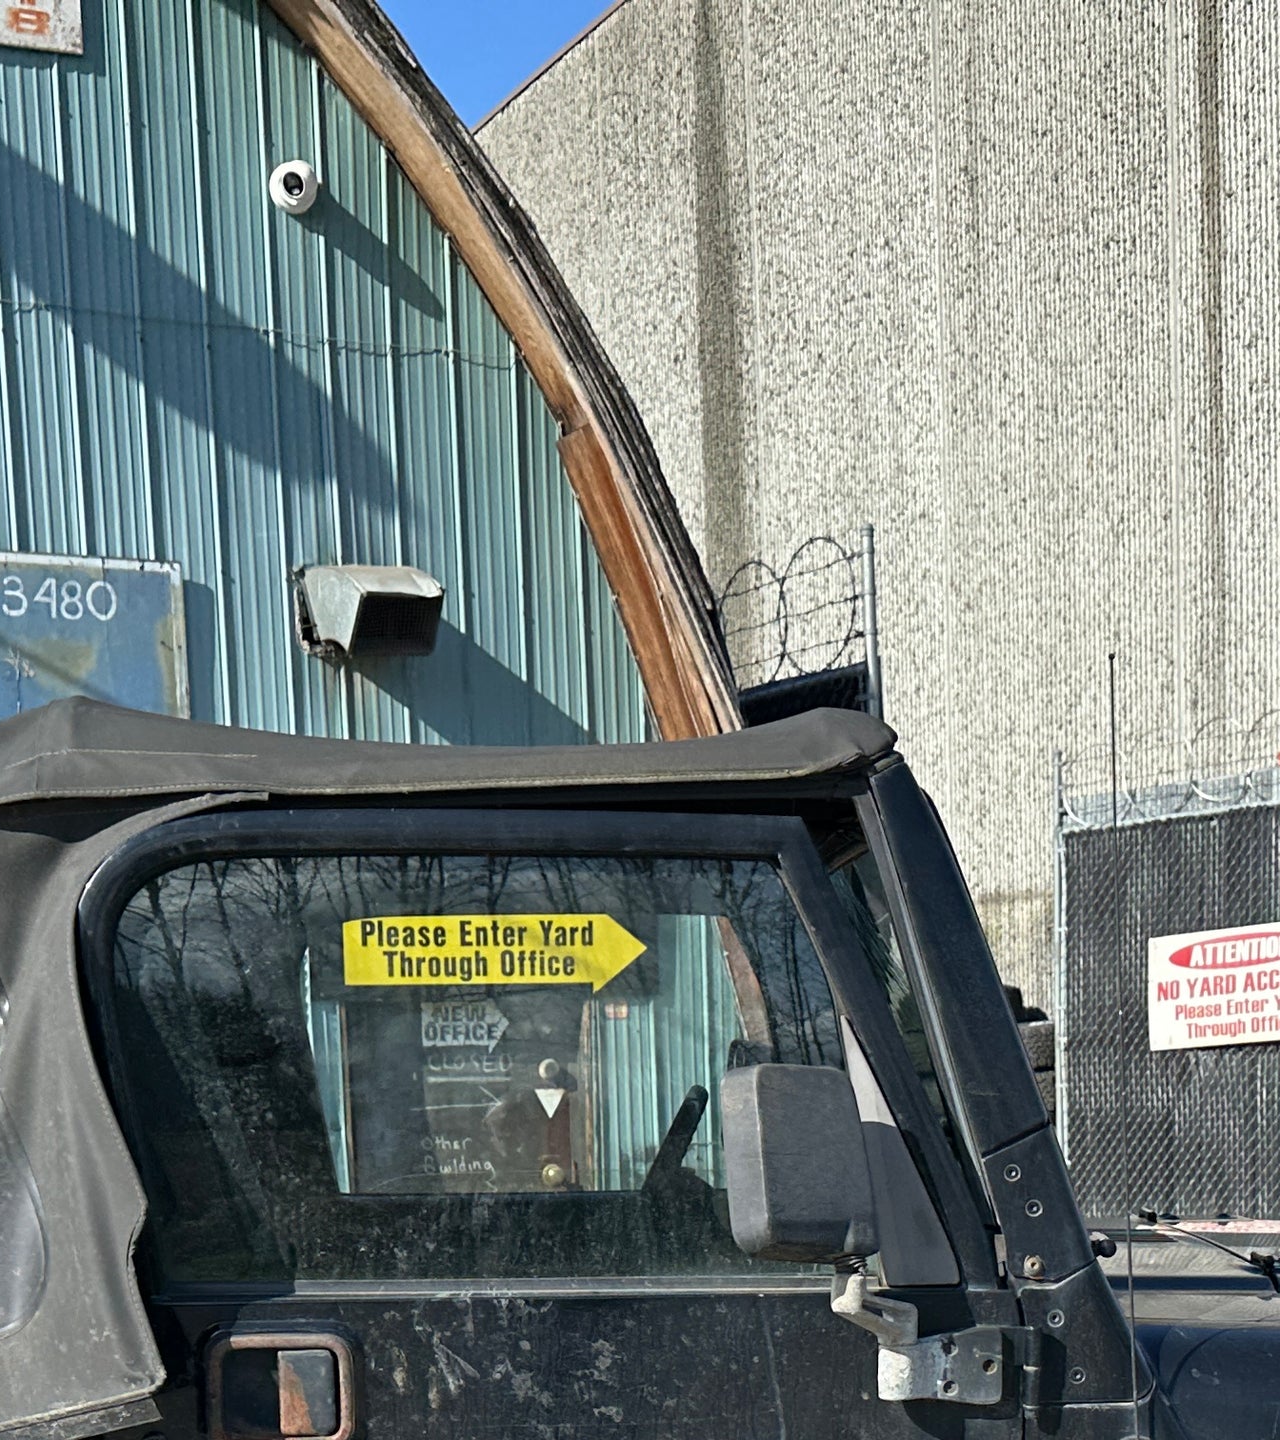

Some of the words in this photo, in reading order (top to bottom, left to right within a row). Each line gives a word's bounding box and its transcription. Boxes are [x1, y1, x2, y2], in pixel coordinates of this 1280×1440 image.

[361, 920, 446, 947] Please
[459, 920, 527, 947] Enter
[539, 920, 594, 947] Yard
[383, 950, 488, 981] Through
[500, 950, 575, 976] Office
[1157, 980, 1180, 1002] NO
[1187, 974, 1237, 999] YARD
[433, 1005, 486, 1022] NEW
[1175, 1003, 1221, 1021] Please
[1227, 998, 1269, 1016] Enter
[424, 1022, 500, 1041] OFFICE
[1187, 1020, 1246, 1039] Through
[428, 1053, 513, 1072] CLOSED
